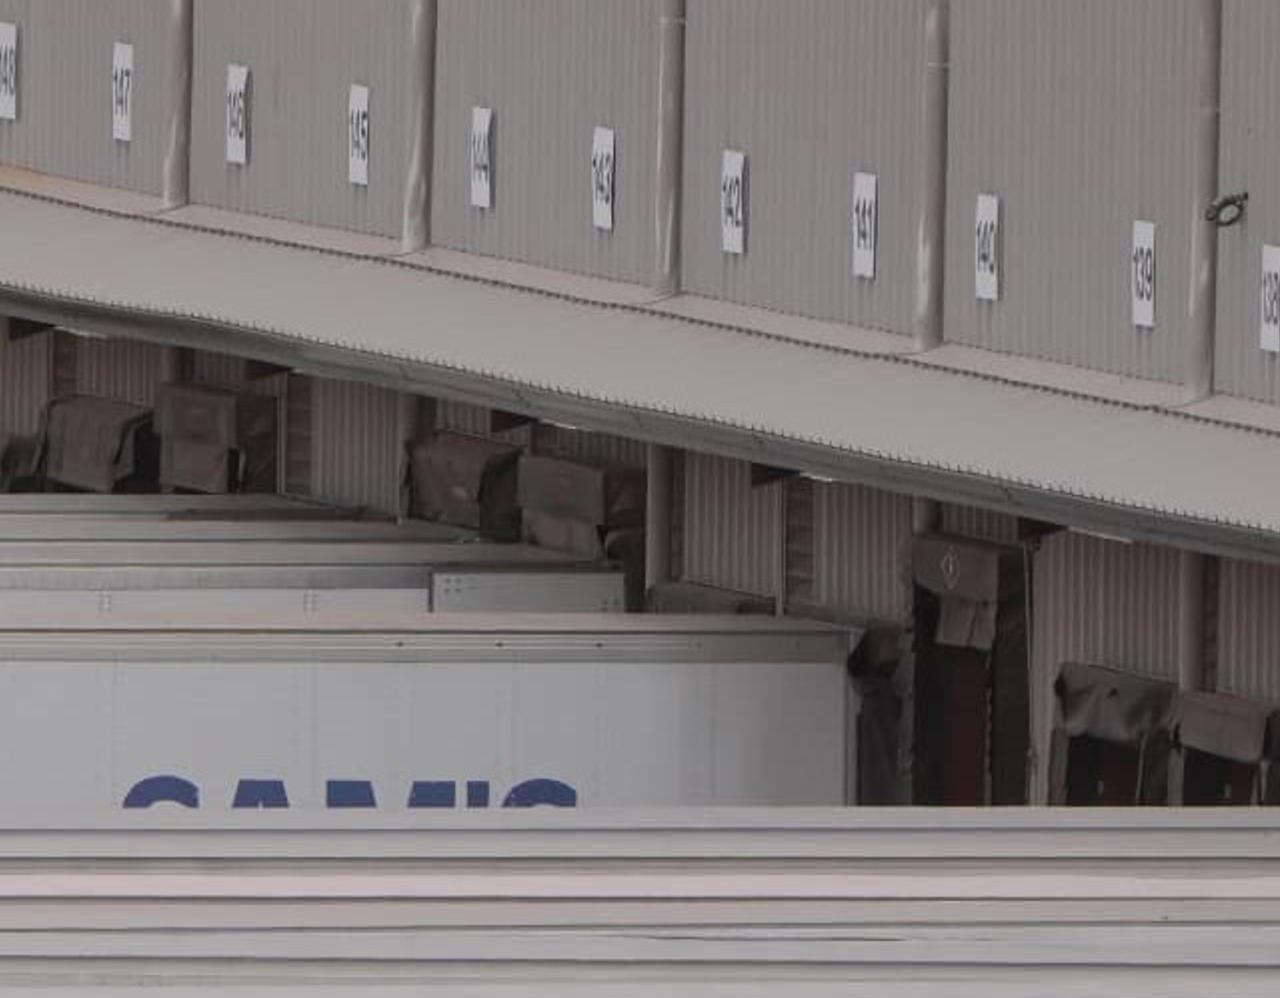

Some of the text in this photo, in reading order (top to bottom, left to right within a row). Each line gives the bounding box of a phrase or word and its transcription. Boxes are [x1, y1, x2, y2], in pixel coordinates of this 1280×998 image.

[114, 67, 131, 116] 147
[351, 109, 368, 160] 145
[723, 178, 741, 228] 142
[855, 199, 873, 251] 141
[1133, 246, 1153, 301] 139
